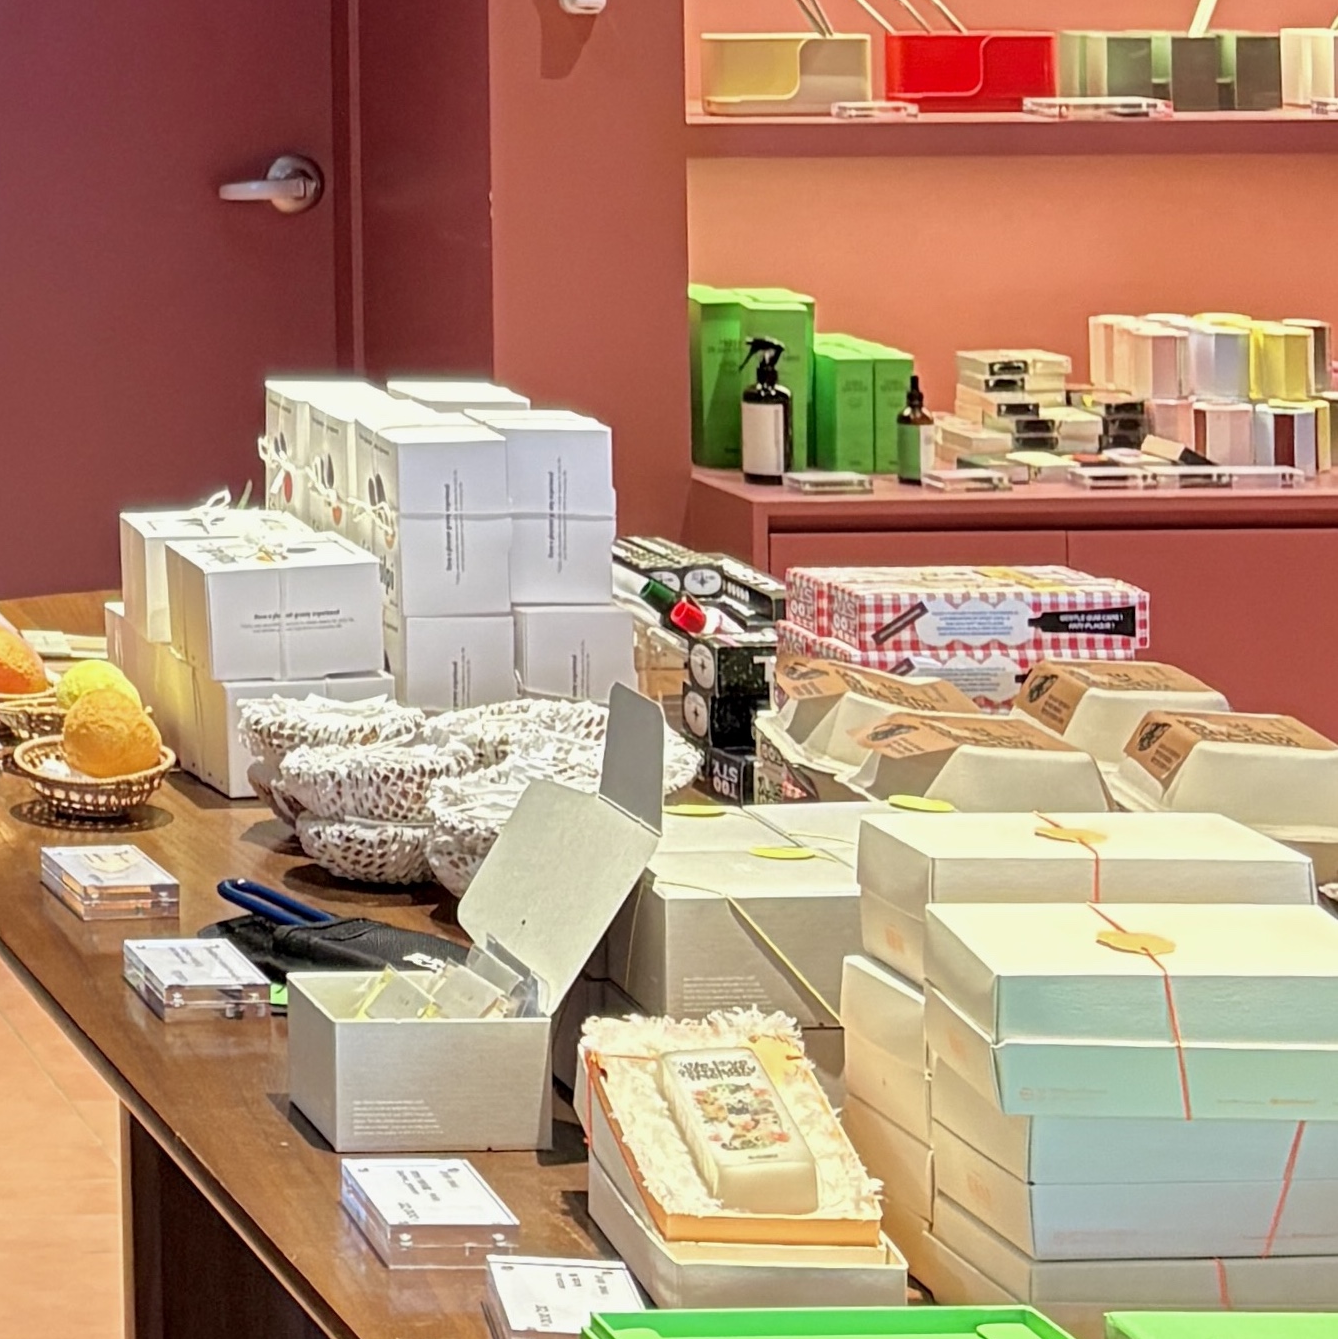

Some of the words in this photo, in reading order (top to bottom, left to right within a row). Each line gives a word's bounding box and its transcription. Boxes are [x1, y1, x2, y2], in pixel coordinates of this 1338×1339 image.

[790, 599, 814, 620] TOO
[833, 613, 856, 635] TOO
[712, 761, 738, 783] STY
[712, 776, 738, 800] TOO
